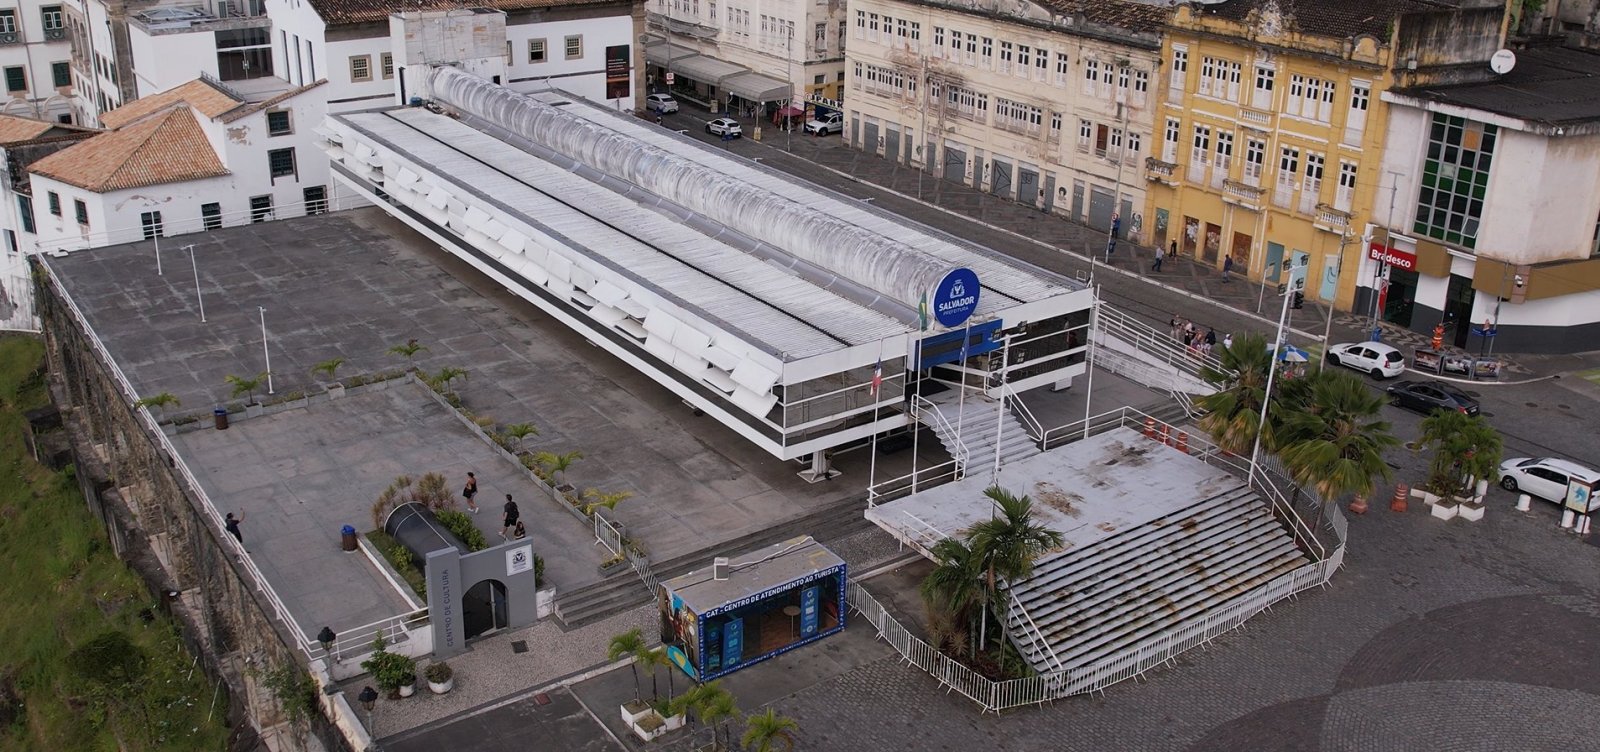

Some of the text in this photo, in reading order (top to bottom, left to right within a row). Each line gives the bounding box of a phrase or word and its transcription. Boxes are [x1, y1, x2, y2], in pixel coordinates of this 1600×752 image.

[1371, 249, 1411, 268] Bradesco
[938, 296, 974, 312] SALVADOR
[943, 306, 969, 316] PREFEITURA
[706, 609, 719, 619] CAT
[724, 598, 751, 612] CENTRO
[750, 594, 760, 603] DE
[760, 579, 804, 600] ATENDIMENTO
[804, 575, 814, 584] AO
[814, 566, 839, 580] TURISTA
[442, 569, 454, 647] CENTRO DE CULTURA
